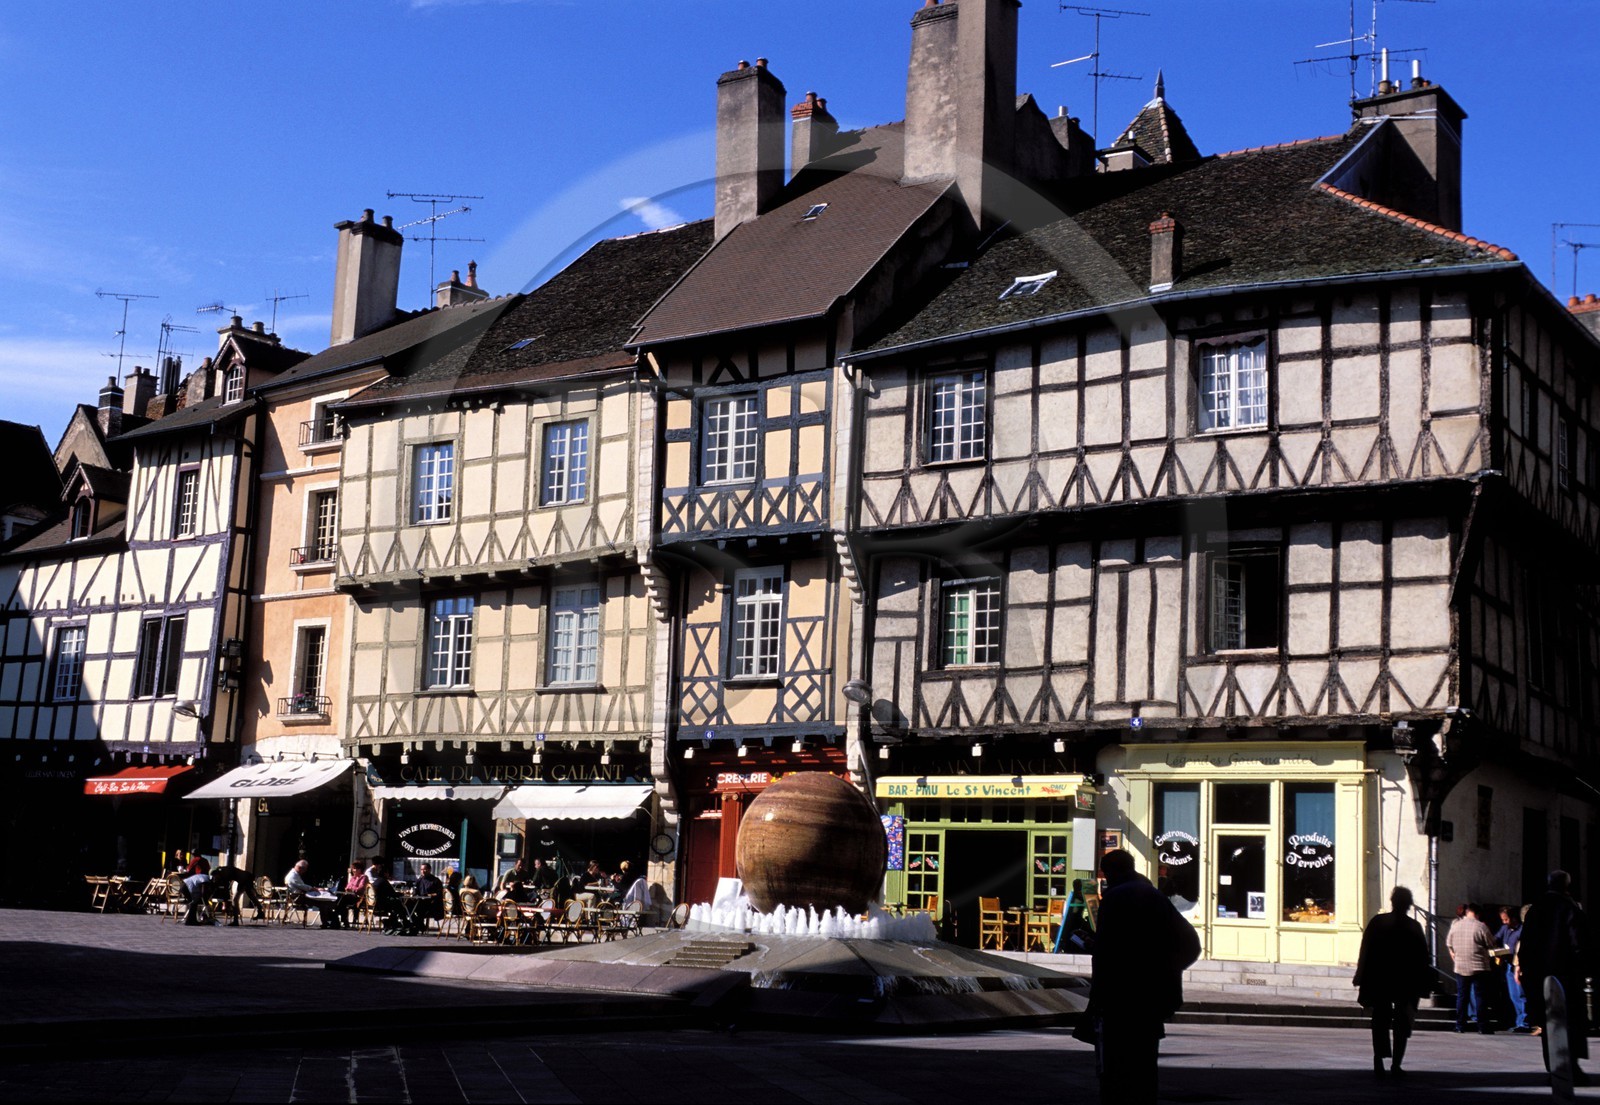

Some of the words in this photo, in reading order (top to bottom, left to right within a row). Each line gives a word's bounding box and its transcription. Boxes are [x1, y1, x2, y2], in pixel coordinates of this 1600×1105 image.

[1228, 751, 1318, 767] Gourmandes
[451, 765, 474, 782] DU
[483, 765, 543, 781] VERRE
[551, 764, 625, 781] GALANT
[716, 773, 768, 784] CREPERIE
[230, 775, 305, 788] GLOBE
[888, 785, 907, 796] BAR
[915, 785, 938, 796] PMU
[946, 784, 960, 796] Le
[964, 784, 979, 796] St
[983, 784, 1032, 796] Vincent
[398, 827, 412, 839] VINS
[410, 824, 420, 833] DE
[419, 823, 456, 840] PROPRIETAIRES
[1154, 830, 1200, 847] Gastronomie
[401, 840, 415, 853] COTE
[415, 840, 452, 856] CHALONNAISE
[1172, 841, 1181, 853] &
[1288, 832, 1333, 850] Produits
[1302, 844, 1317, 855] des
[1159, 852, 1193, 866] Cadeaux
[1285, 851, 1334, 869] Terroirs
